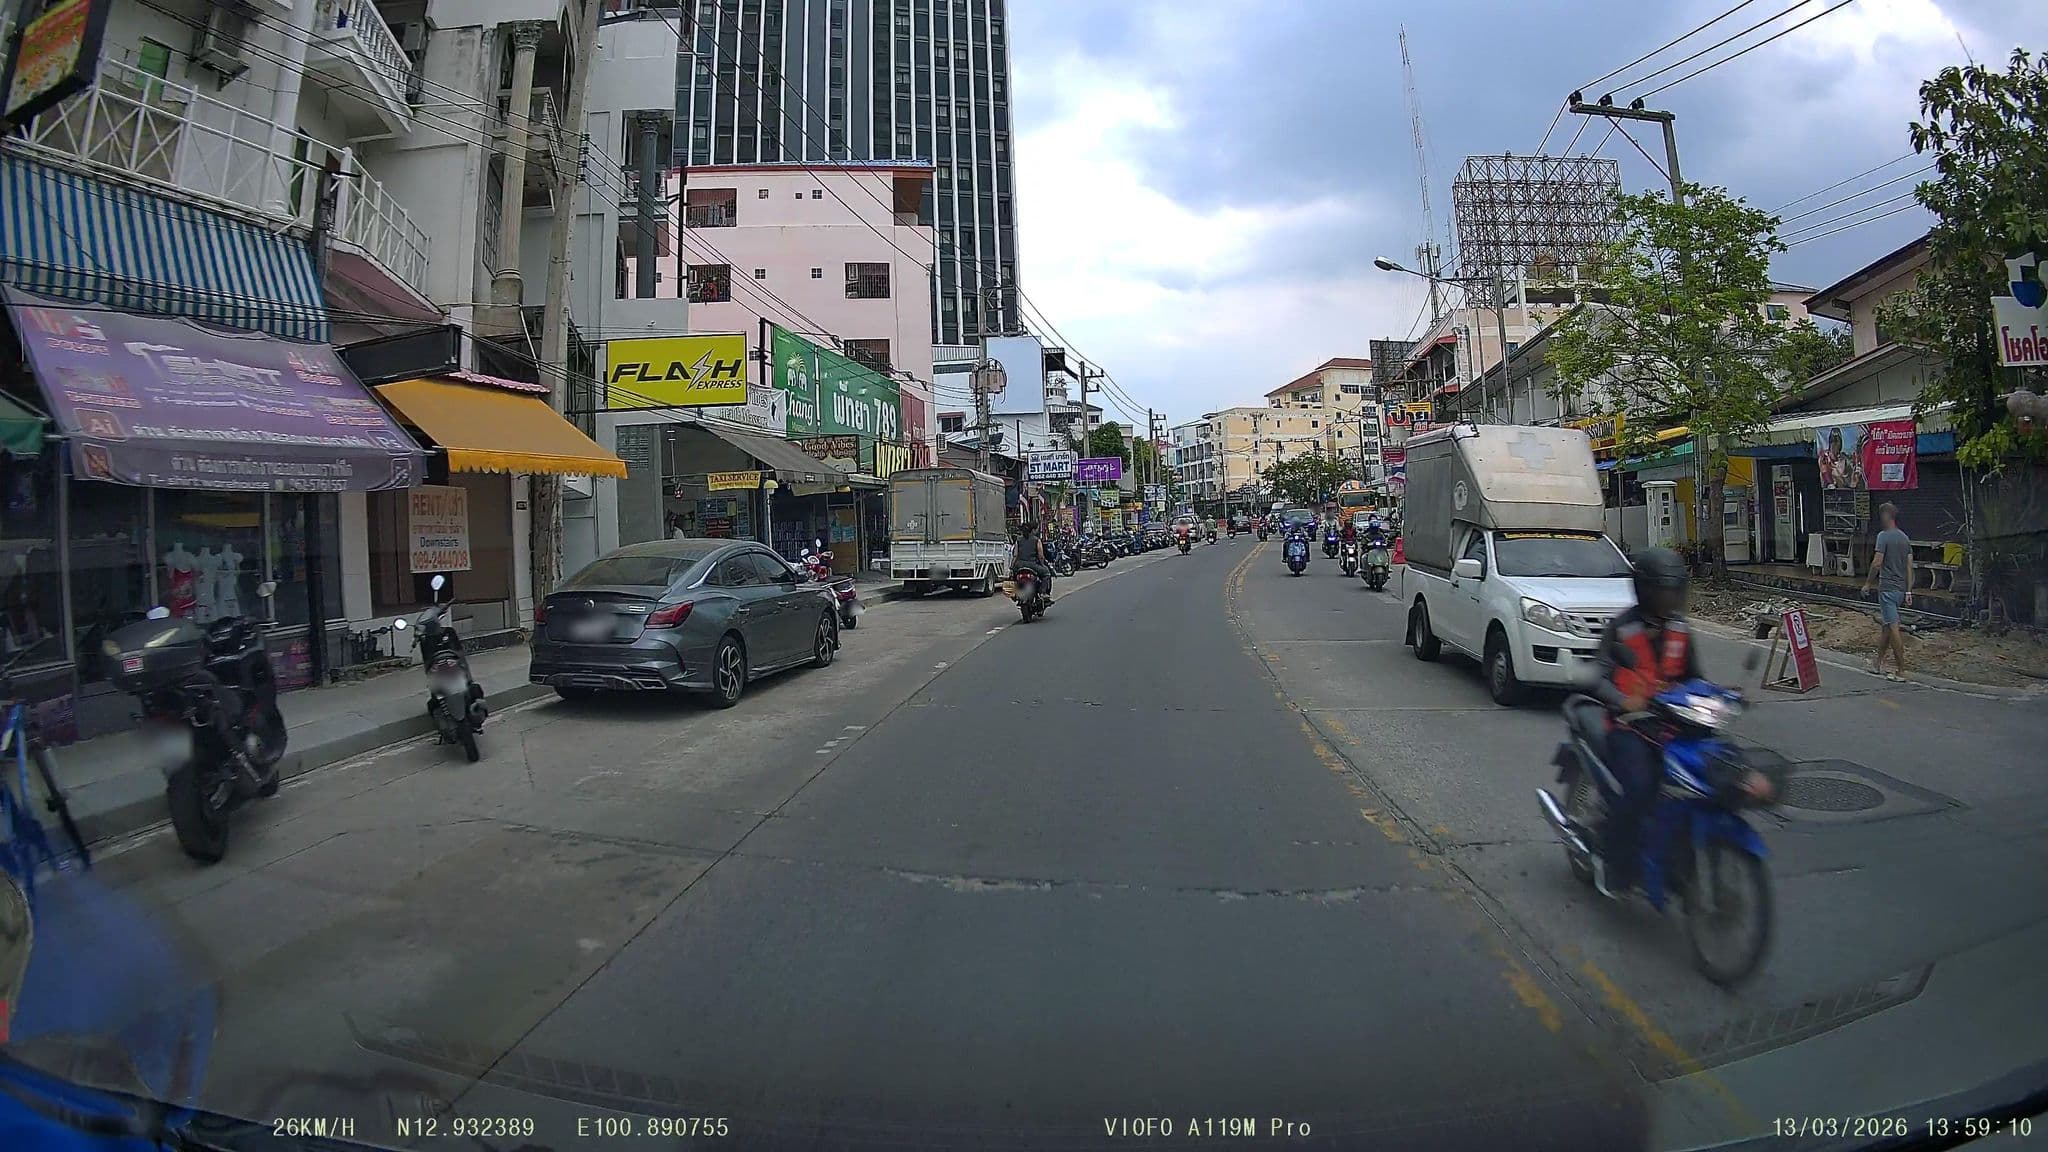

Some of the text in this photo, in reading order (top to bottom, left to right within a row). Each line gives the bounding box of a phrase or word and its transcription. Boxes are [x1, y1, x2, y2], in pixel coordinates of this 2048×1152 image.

[611, 353, 742, 389] FLASH
[696, 380, 742, 390] EXPRESS
[833, 380, 871, 433] พัทยา
[874, 398, 897, 441] 789
[804, 440, 854, 450] Good Vibes
[1030, 461, 1070, 472] ST MART
[727, 472, 758, 482] SERVICE
